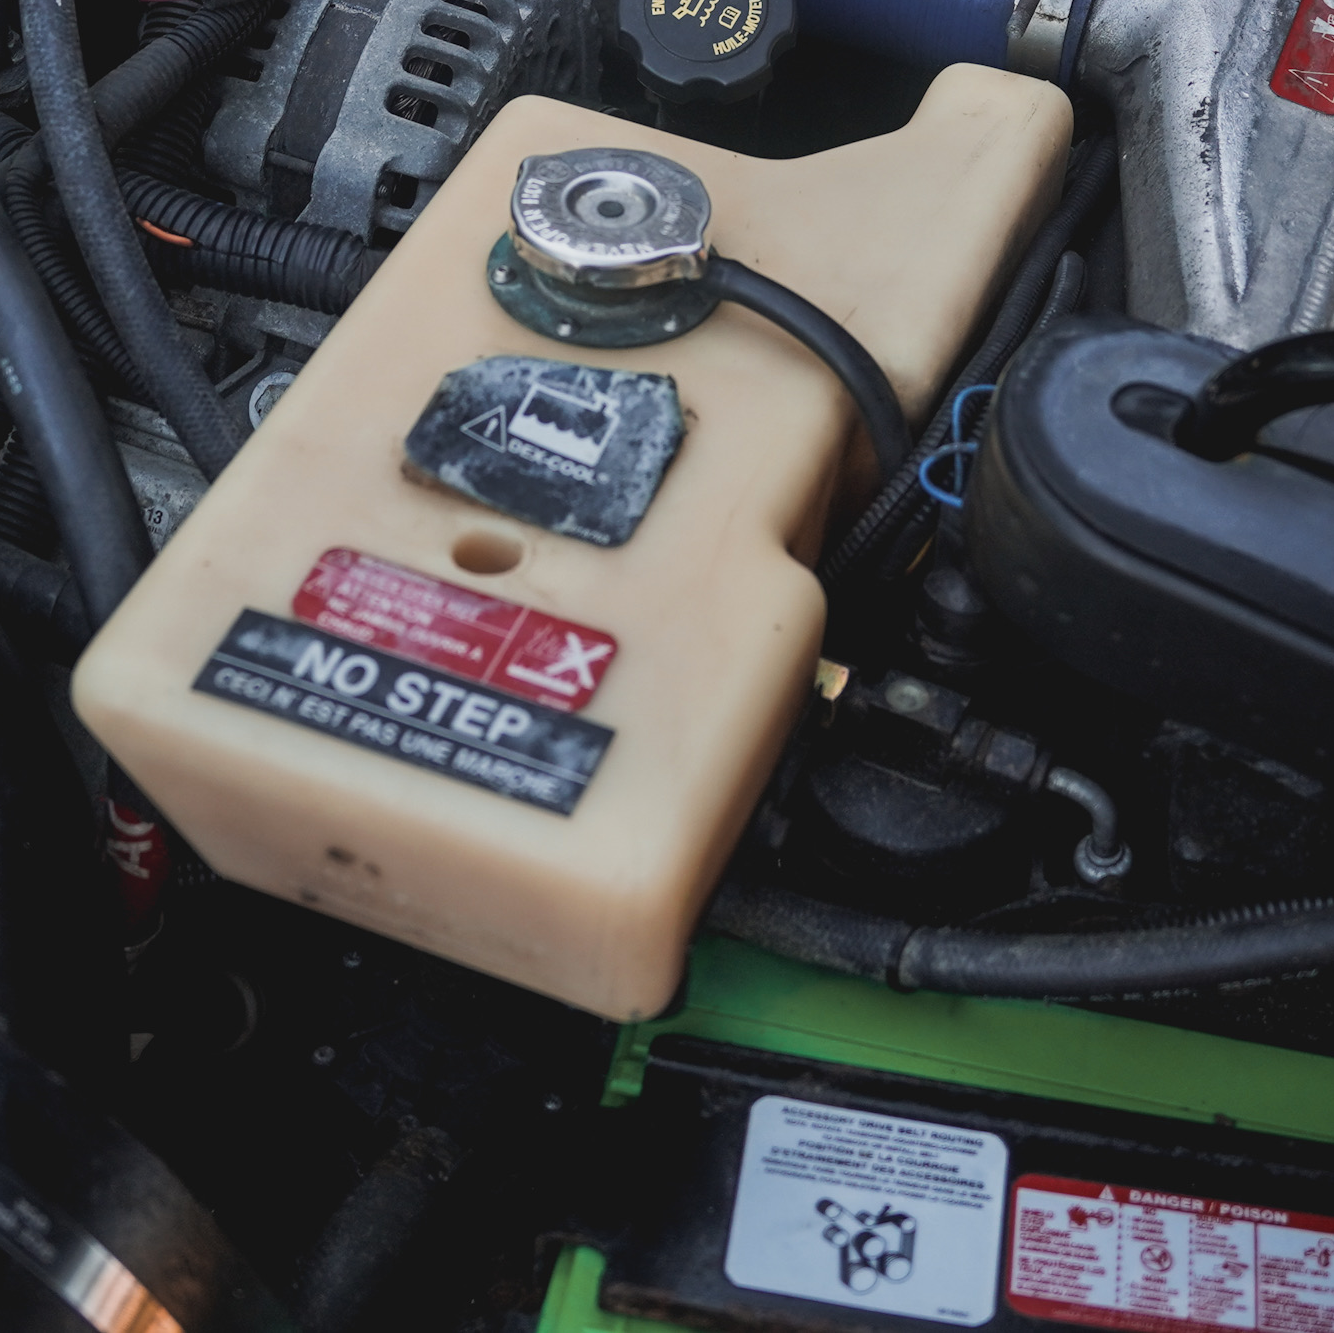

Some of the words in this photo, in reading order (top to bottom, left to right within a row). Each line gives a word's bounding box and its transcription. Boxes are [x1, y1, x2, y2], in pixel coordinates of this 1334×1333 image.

[213, 666, 269, 699] CECI
[298, 696, 350, 728] EST
[349, 710, 399, 747] PAS
[399, 727, 453, 767] UNE
[292, 639, 381, 698] NO
[385, 671, 533, 744] STEP
[858, 1117, 894, 1133] DRIVE
[929, 1129, 985, 1149] ROUTING
[1128, 1188, 1206, 1213] DANGER
[1218, 1201, 1289, 1225] POISON
